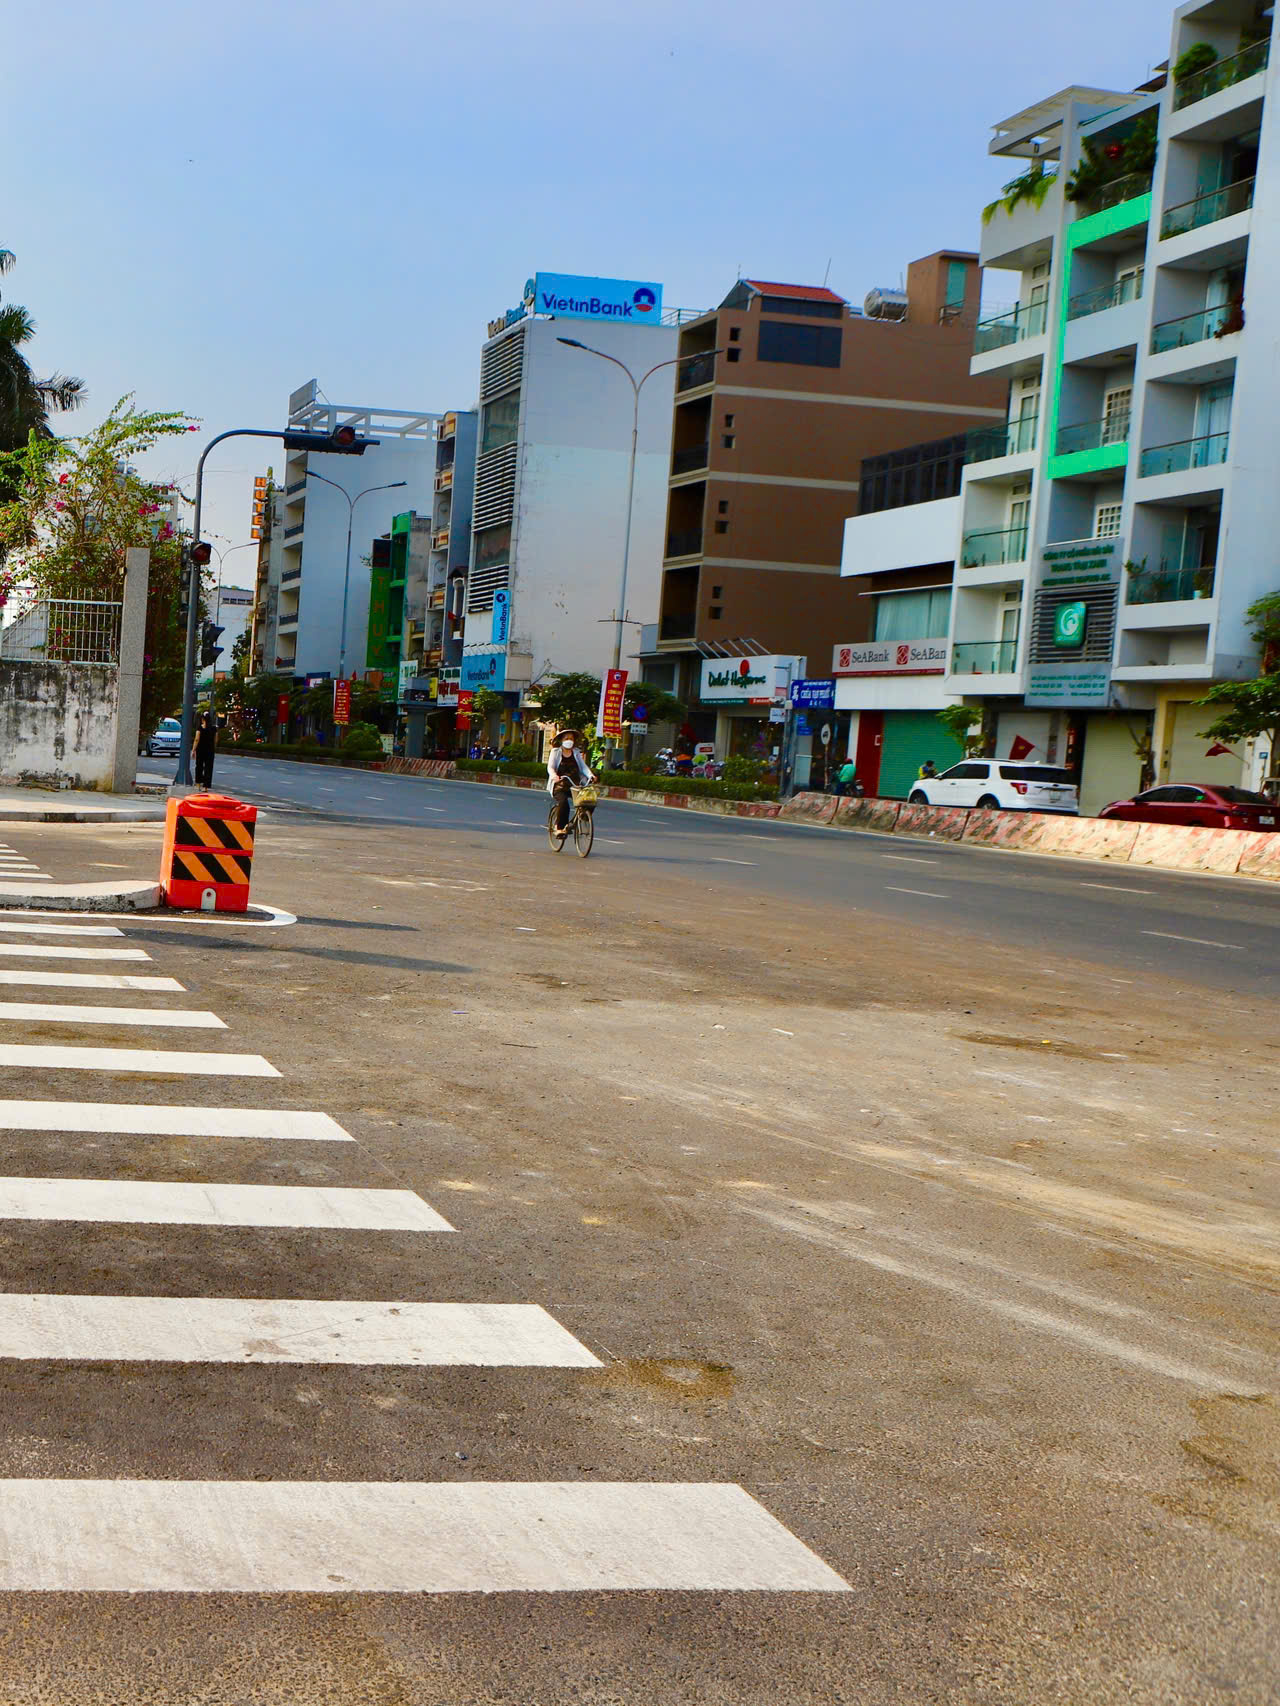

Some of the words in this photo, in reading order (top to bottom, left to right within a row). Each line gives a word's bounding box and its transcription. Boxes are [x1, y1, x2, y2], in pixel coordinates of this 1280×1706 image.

[542, 293, 632, 317] VietinBank
[851, 649, 889, 663] SeABank
[910, 648, 946, 661] SeABan
